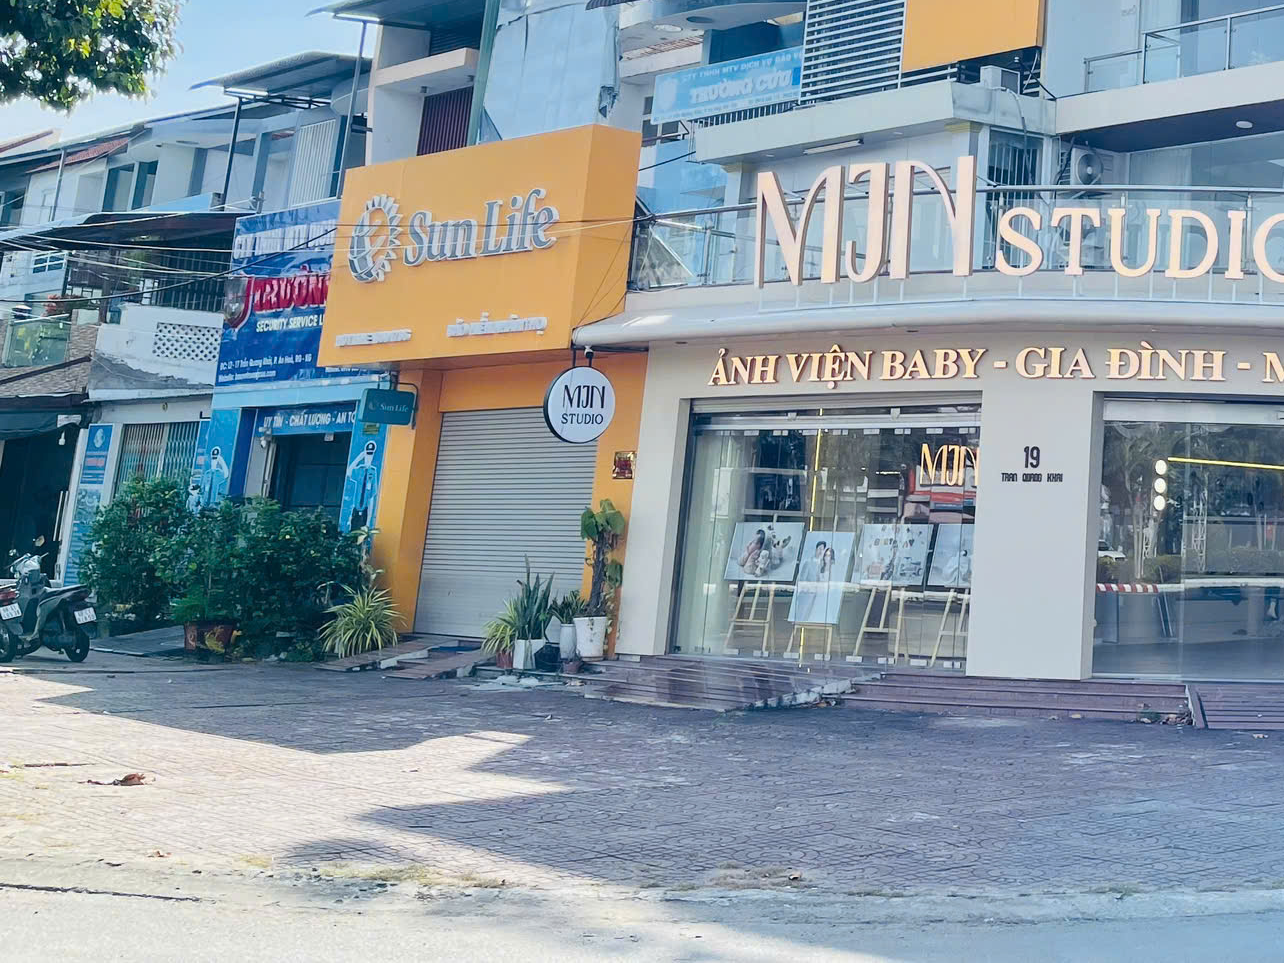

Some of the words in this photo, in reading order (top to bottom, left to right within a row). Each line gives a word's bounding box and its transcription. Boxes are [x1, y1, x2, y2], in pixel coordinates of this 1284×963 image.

[403, 209, 478, 267] Sun
[479, 188, 560, 258] Life
[753, 155, 977, 289] MJN
[256, 318, 288, 333] SECURITY
[289, 314, 318, 329] SERVICE
[707, 347, 779, 387] ẢNH
[787, 343, 875, 390] VIỆN
[879, 347, 988, 381] BABY
[1015, 347, 1096, 380] GIA
[1105, 340, 1228, 382] ĐÌNH
[380, 403, 394, 411] Sun
[395, 404, 409, 413] Life
[562, 384, 605, 409] MJN
[561, 413, 604, 425] STUDIO
[919, 442, 980, 486] MJN
[1023, 446, 1041, 469] 19
[1001, 472, 1018, 482] TRAN
[1022, 472, 1043, 483] QUANG
[1046, 473, 1064, 483] KHAI
